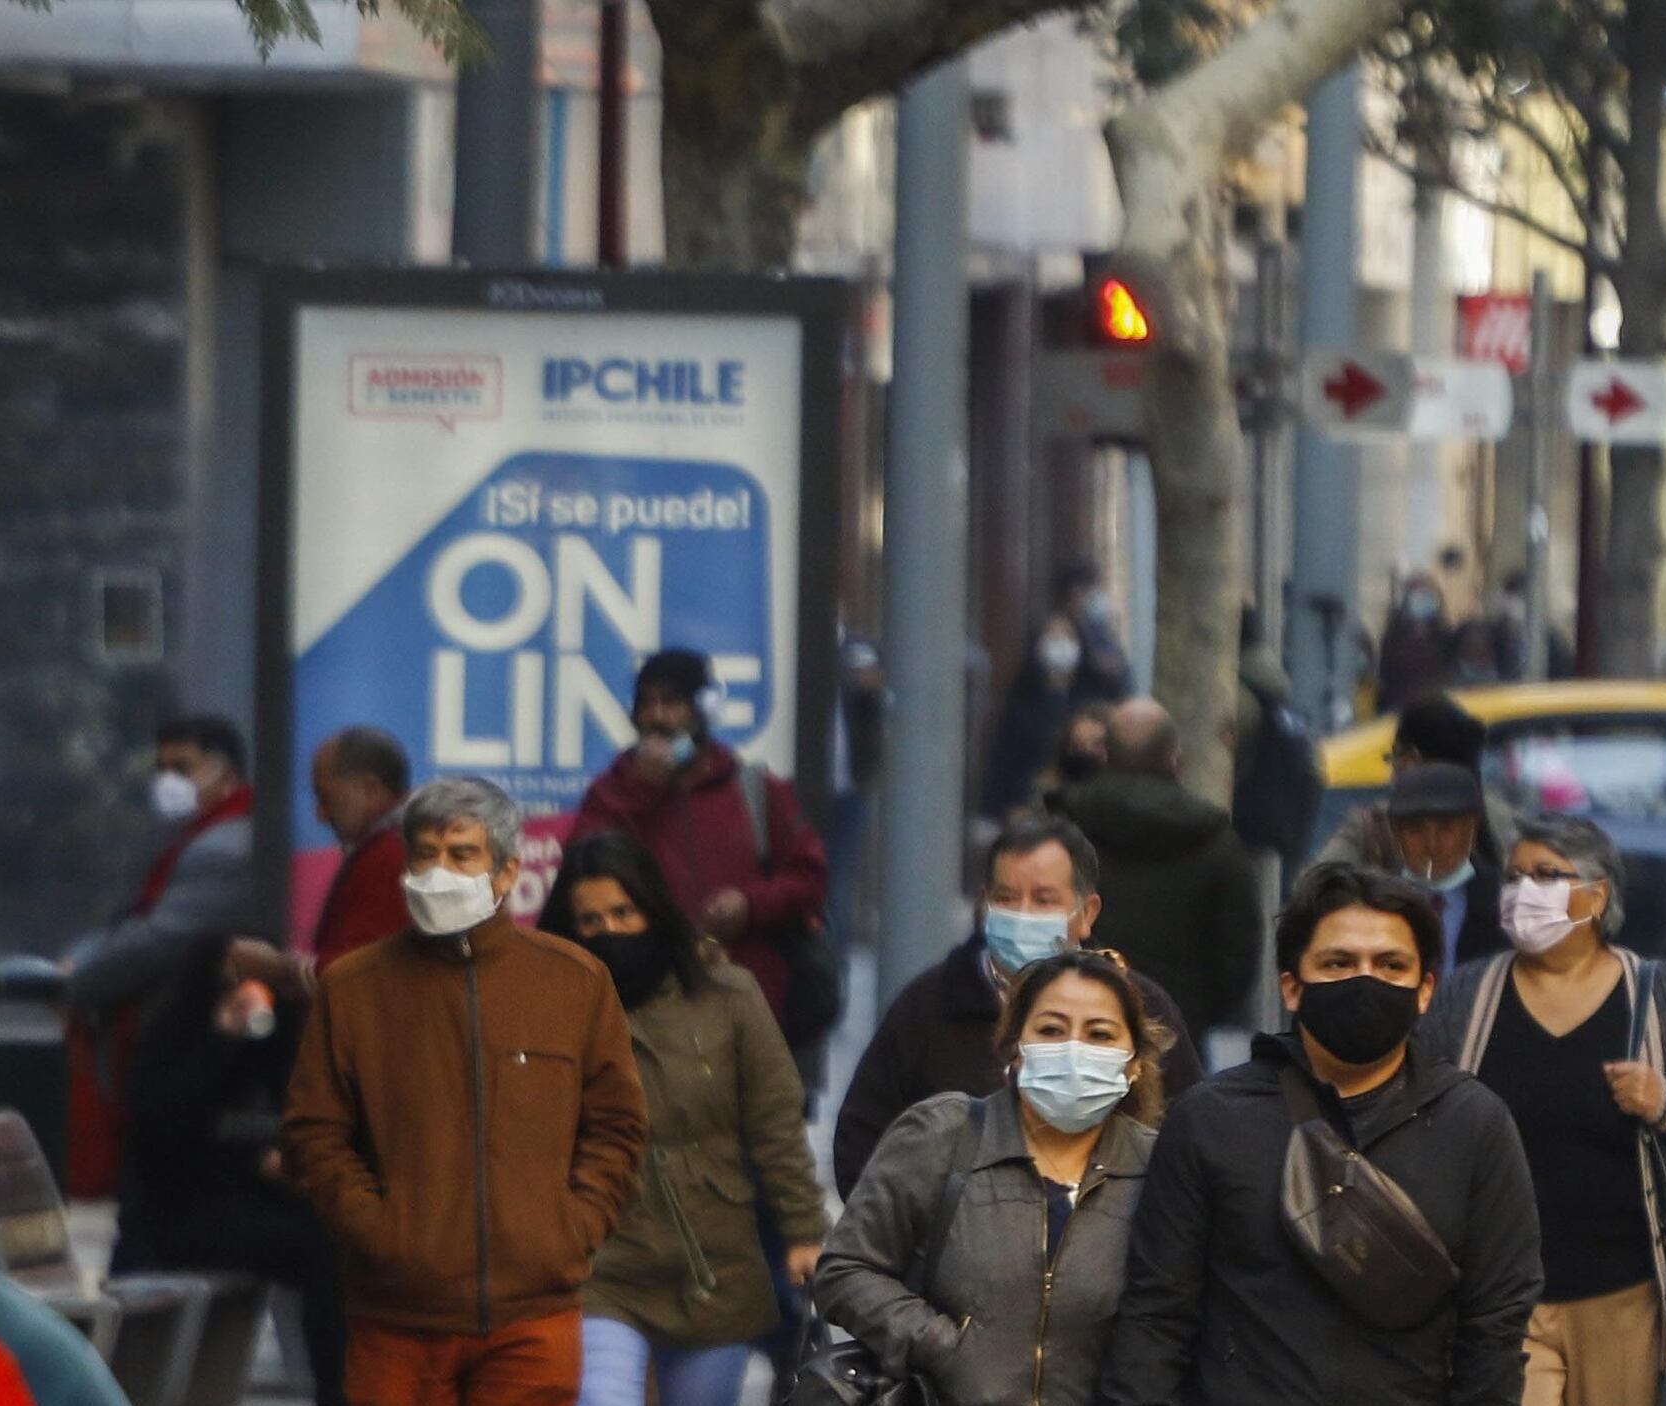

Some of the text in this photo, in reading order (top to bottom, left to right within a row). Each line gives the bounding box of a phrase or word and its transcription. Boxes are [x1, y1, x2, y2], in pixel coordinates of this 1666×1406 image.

[543, 358, 745, 405] IPCHILE
[549, 490, 599, 527] se
[429, 531, 662, 650] ON
